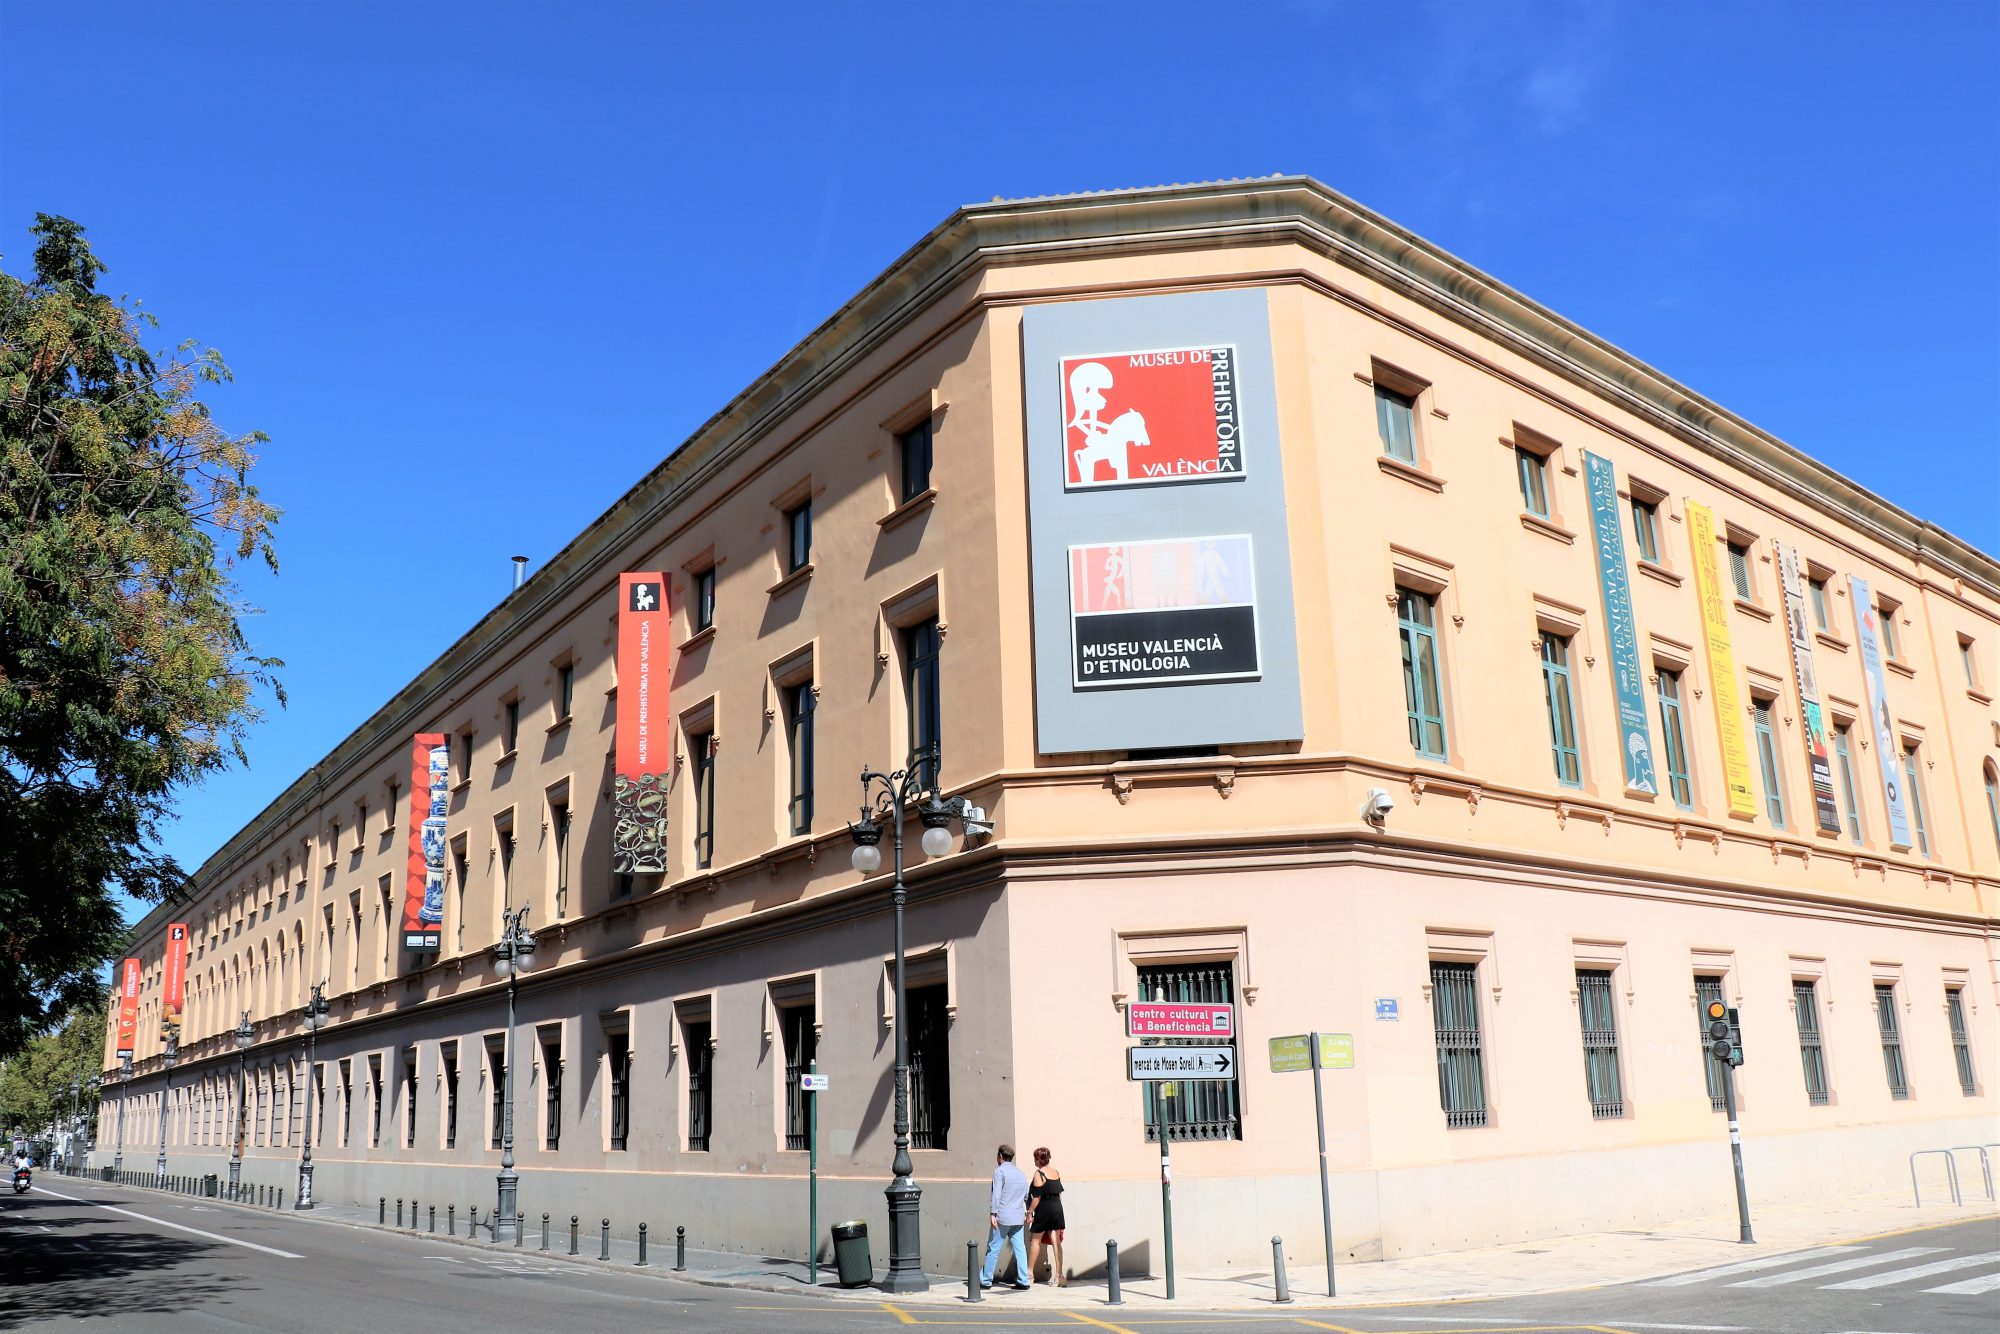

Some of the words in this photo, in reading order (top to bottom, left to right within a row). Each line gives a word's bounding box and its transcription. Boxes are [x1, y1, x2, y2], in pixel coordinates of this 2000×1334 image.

[1129, 352, 1185, 368] MUSEU
[1190, 350, 1211, 364] DE
[1142, 457, 1236, 477] VALÈNCIA
[1593, 476, 1606, 512] VAS
[1599, 518, 1613, 559] DEL
[1614, 560, 1624, 581] DE
[1618, 587, 1633, 648] MESTRA
[640, 620, 649, 661] VALÈNCIA
[1083, 641, 1139, 658] MUSEU
[1143, 633, 1223, 655] VALENCIÀ
[640, 662, 649, 673] DE
[1083, 656, 1190, 675] D'ETNOLOGIA
[1627, 653, 1640, 696] OBRA
[639, 725, 647, 735] DE
[639, 737, 647, 764] MUSEU
[1133, 1009, 1165, 1018] centre
[1170, 1009, 1208, 1019] cultural
[1133, 1021, 1143, 1030] la
[1147, 1021, 1210, 1031] Beneficència
[1134, 1057, 1152, 1070] mercat
[1154, 1057, 1160, 1070] de
[1161, 1056, 1177, 1070] Mosen
[1179, 1056, 1195, 1070] Sorell
